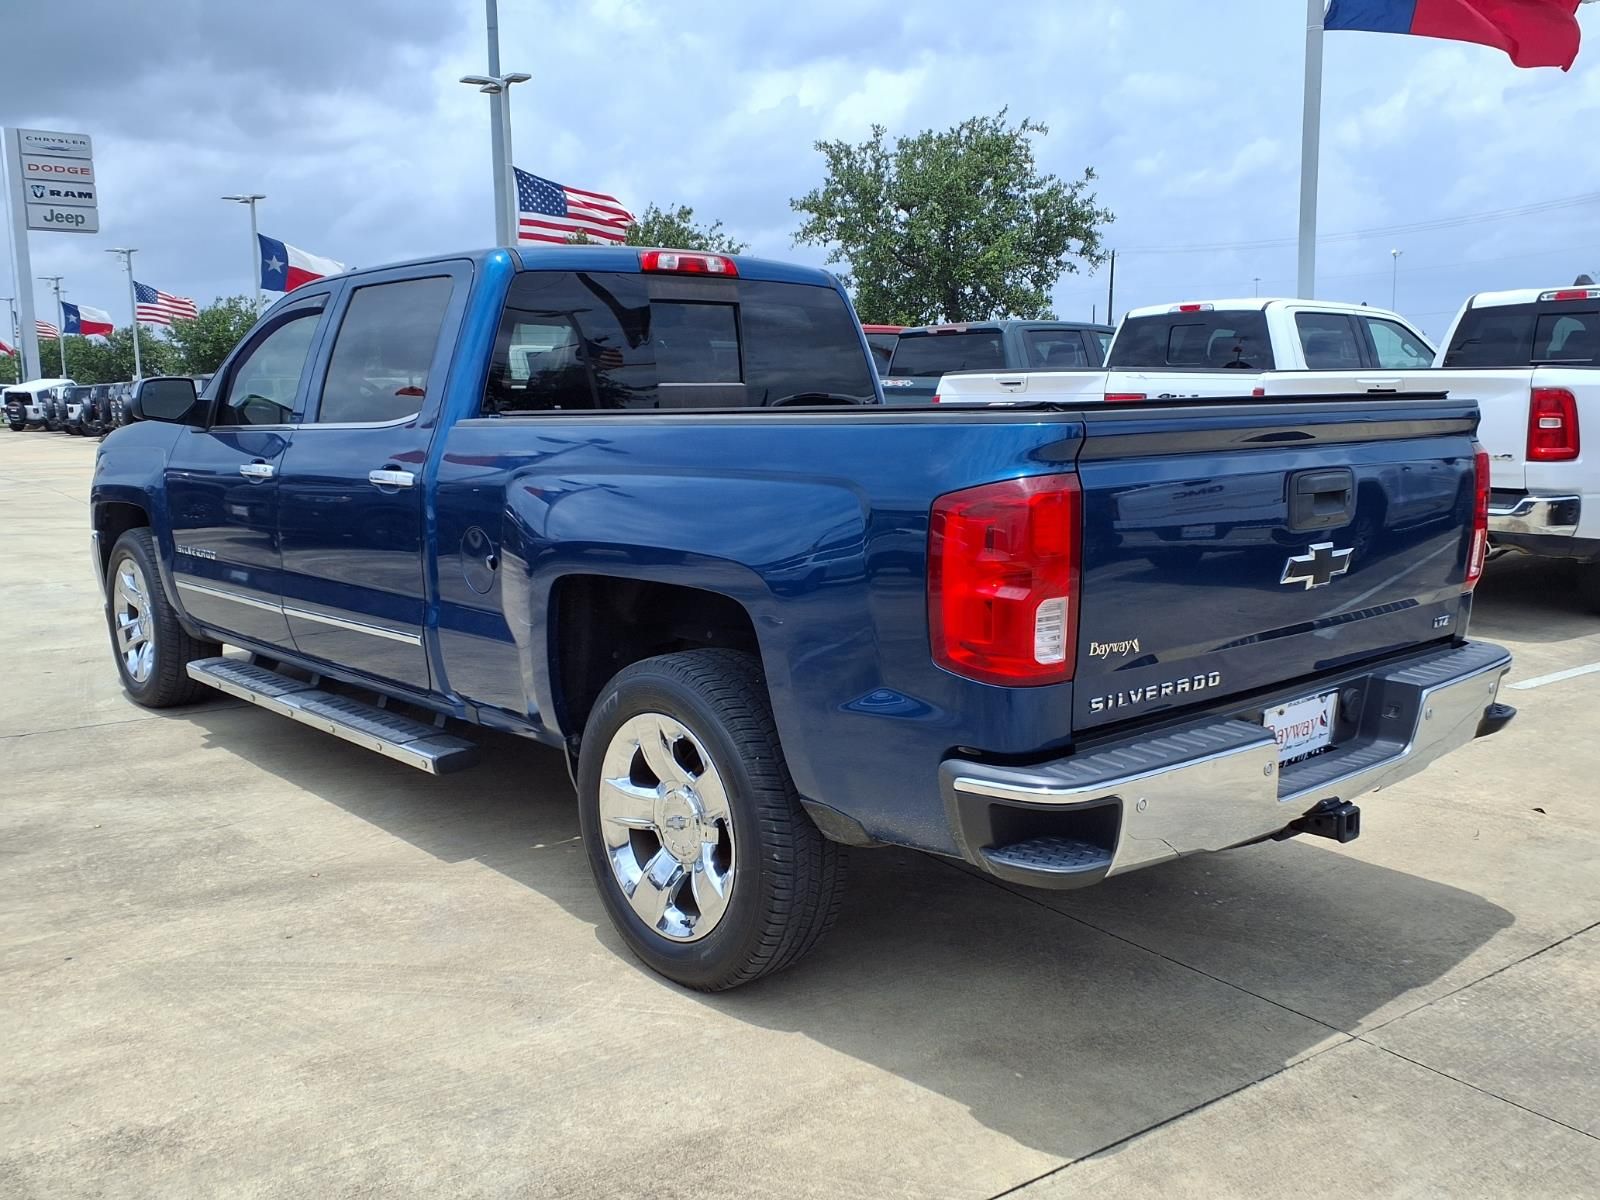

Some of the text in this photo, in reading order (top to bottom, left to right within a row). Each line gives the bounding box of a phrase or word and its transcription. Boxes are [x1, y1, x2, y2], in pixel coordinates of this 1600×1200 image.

[25, 135, 87, 146] CHRYSLER
[27, 163, 91, 176] DODGE
[49, 189, 94, 199] RAM
[43, 208, 86, 227] Jeep
[1089, 640, 1135, 660] Bayway
[1089, 671, 1222, 715] SILVERADO
[1265, 716, 1319, 753] ayway
